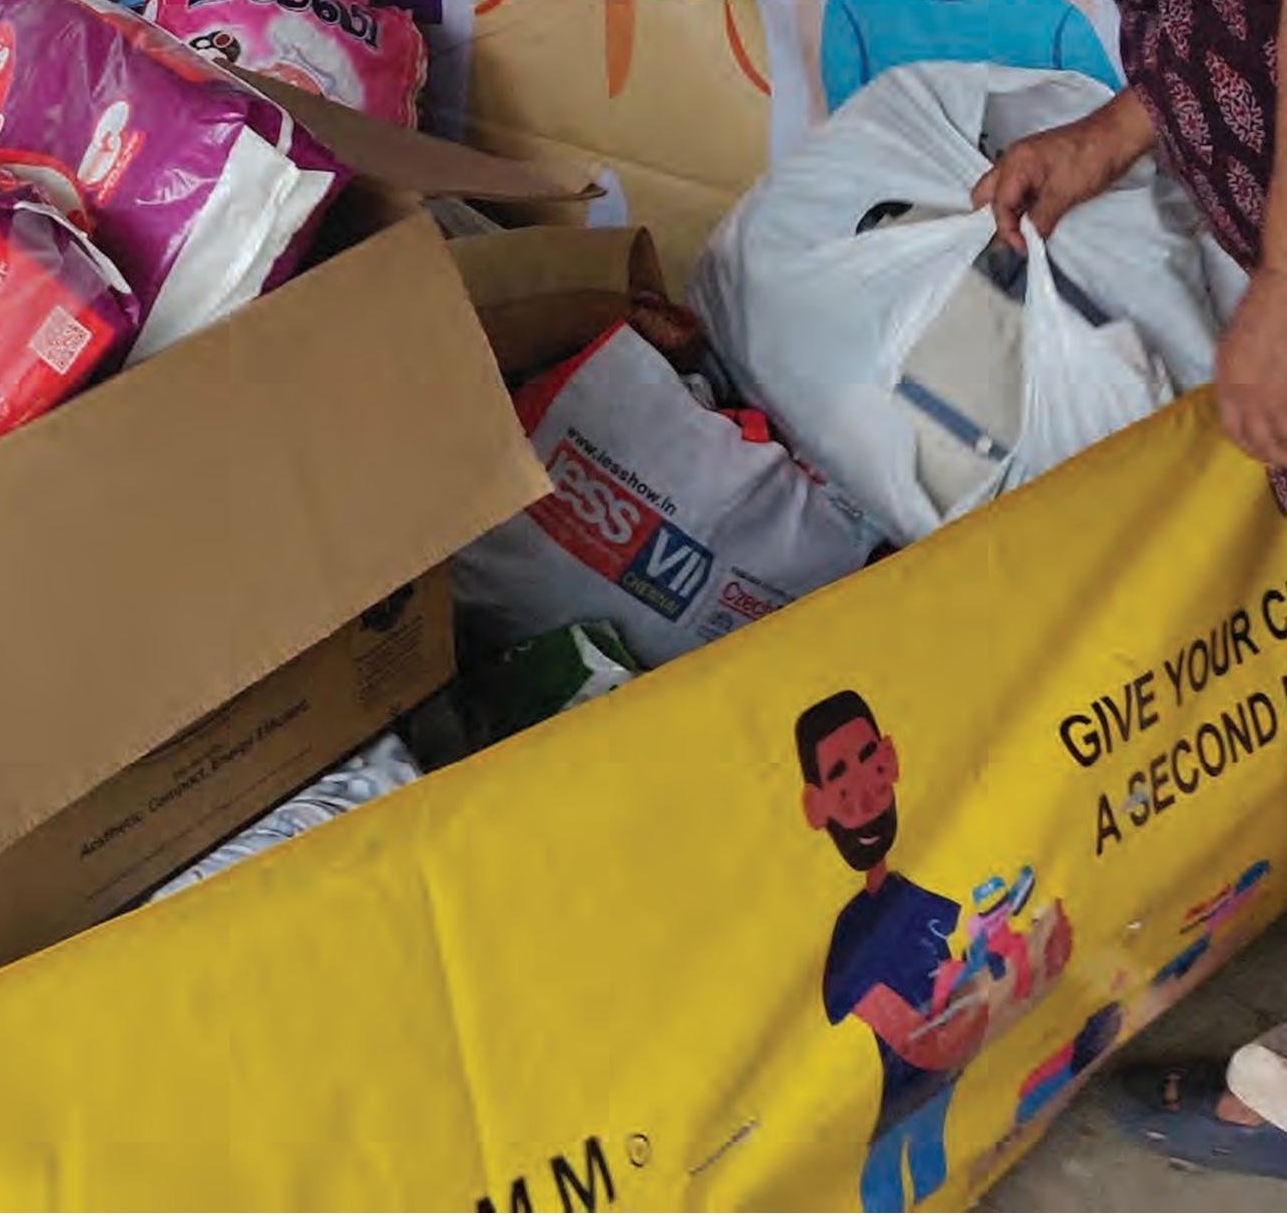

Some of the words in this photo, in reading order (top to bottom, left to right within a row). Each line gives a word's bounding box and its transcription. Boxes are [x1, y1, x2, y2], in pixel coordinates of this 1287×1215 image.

[567, 424, 678, 517] www.iesshow.in
[1059, 670, 1159, 768] GIVE
[1163, 609, 1260, 708] YOUR
[1096, 793, 1122, 856] A
[1128, 692, 1278, 827] SECOND
